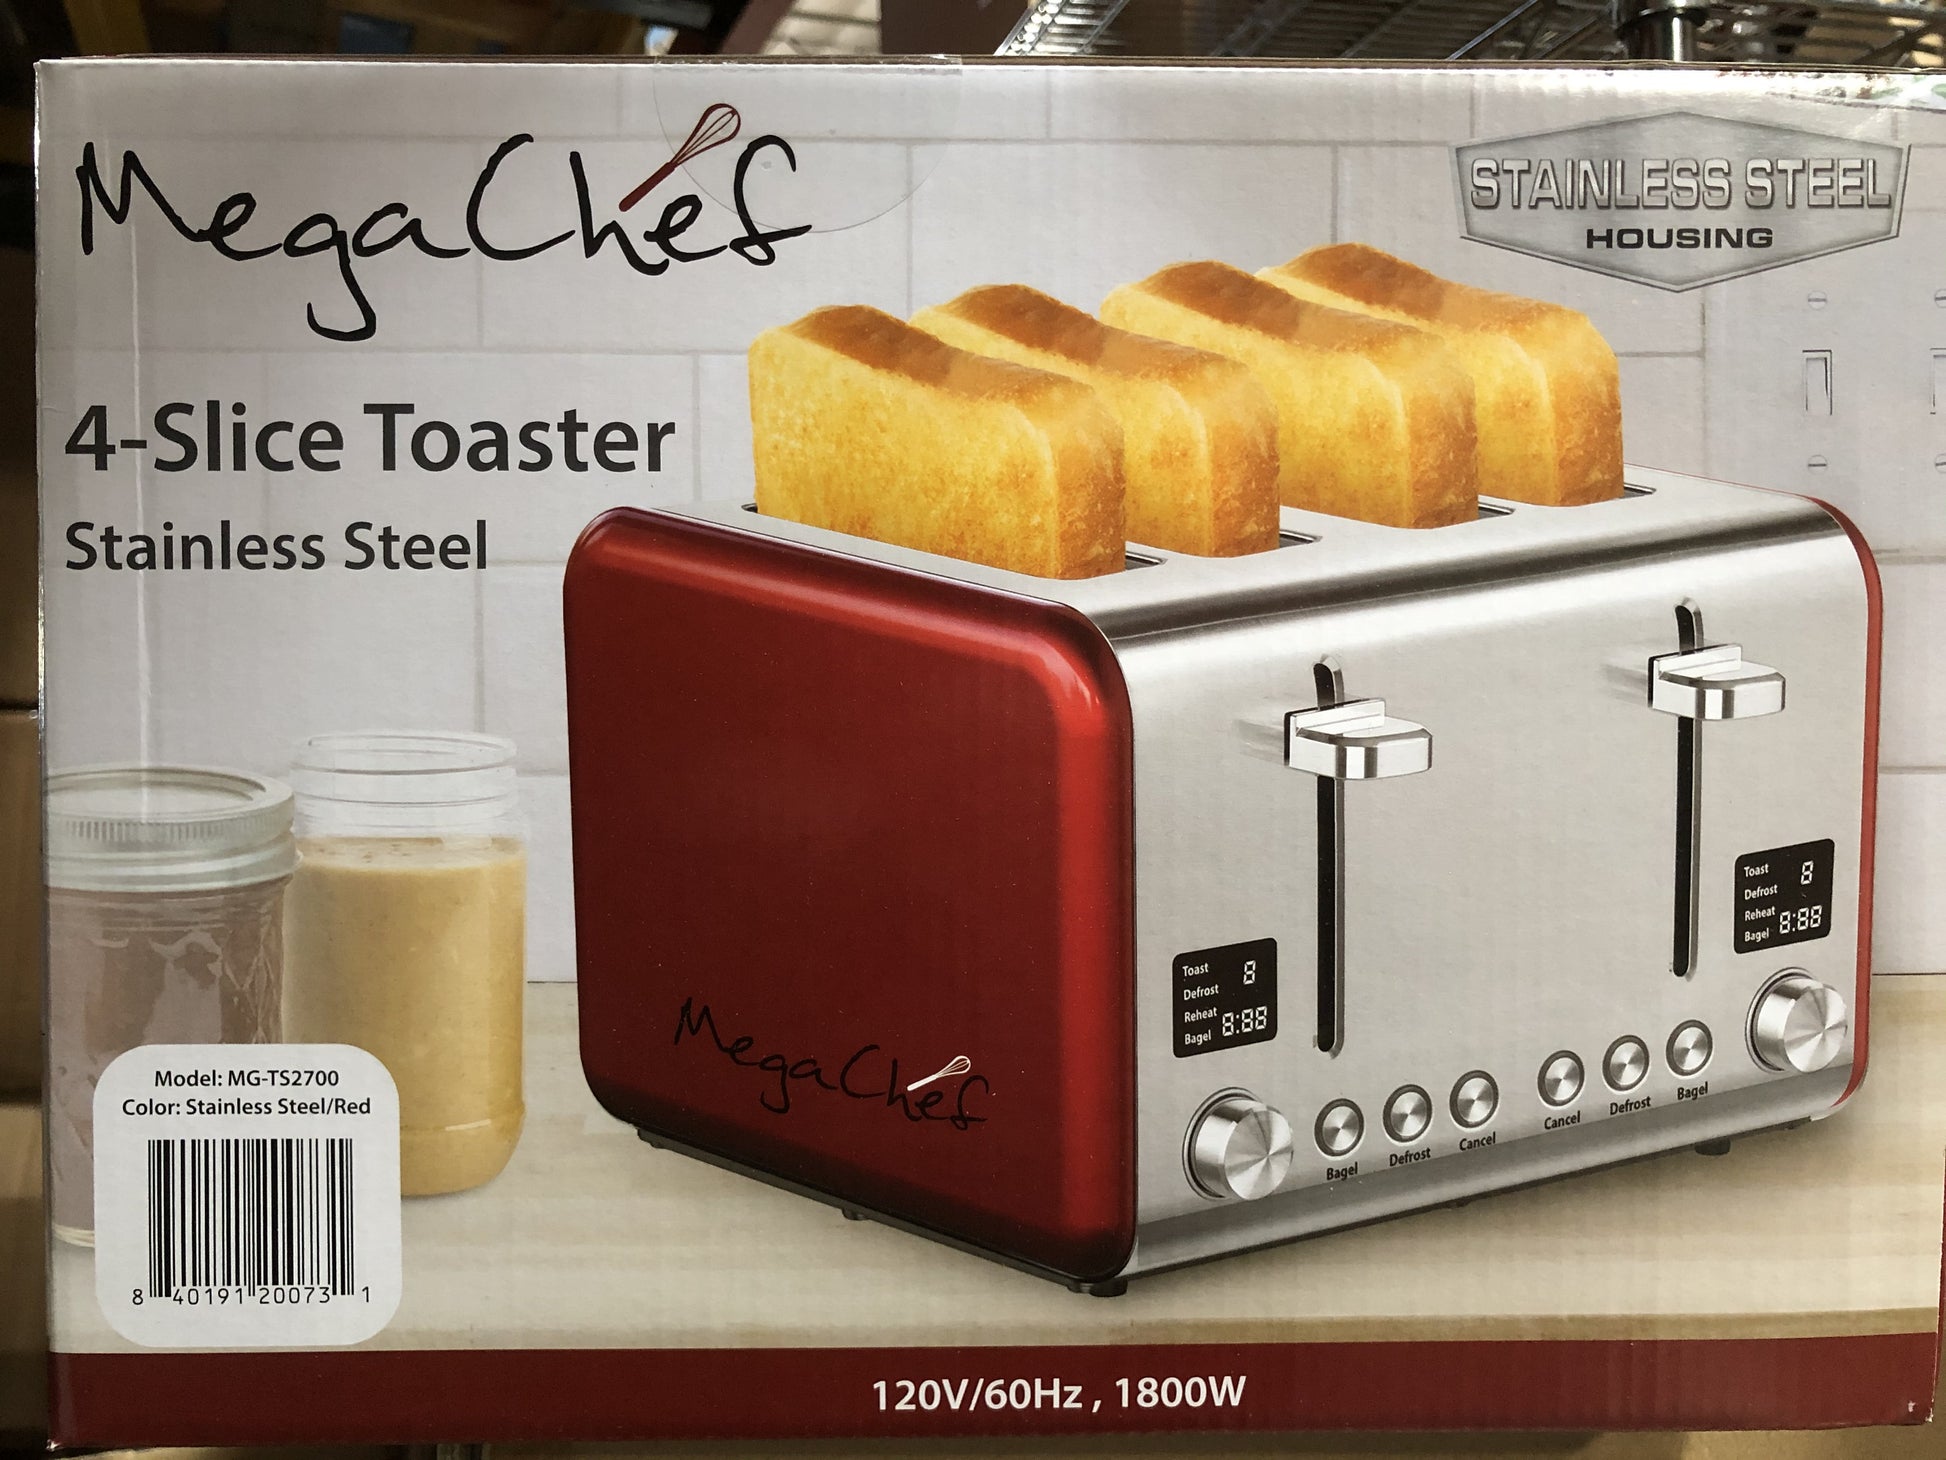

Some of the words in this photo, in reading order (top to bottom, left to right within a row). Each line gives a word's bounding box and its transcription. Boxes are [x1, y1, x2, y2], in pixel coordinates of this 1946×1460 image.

[1470, 158, 1732, 210] STAINLESS
[1744, 158, 1892, 208] STEEL
[76, 133, 812, 342] MegaChef
[1586, 228, 1774, 249] HOUSING
[64, 402, 345, 473] 4-Slice
[363, 403, 676, 472] Toaster
[65, 521, 325, 570] Stainless
[344, 519, 488, 570] Steel
[1744, 863, 1769, 877] Toast
[1744, 884, 1778, 900] Defrost
[1744, 906, 1776, 922] Reheat
[1744, 927, 1770, 942] Bagel
[1182, 962, 1209, 977] Toast
[1183, 983, 1219, 1001] Defrost
[1184, 1006, 1218, 1023] Reheat
[1184, 1029, 1212, 1046] Bagel
[673, 997, 989, 1131] MegaChef
[154, 1070, 223, 1087] Model:
[228, 1070, 339, 1087] MG-TS2700
[1677, 1081, 1709, 1100] Bagel
[122, 1098, 181, 1116] Color:
[186, 1098, 273, 1115] Stainless
[278, 1097, 372, 1115] Steel/Red
[1609, 1095, 1652, 1116] Defrost
[1544, 1110, 1581, 1131] Cancel
[1459, 1131, 1497, 1152] Cancel
[1389, 1147, 1432, 1168] Defrost
[1326, 1161, 1359, 1183] Bagel
[132, 1288, 144, 1305] 8
[172, 1288, 243, 1305] 40191
[259, 1286, 331, 1304] 20073
[361, 1286, 370, 1303] 1
[1115, 1375, 1247, 1408] 1800W
